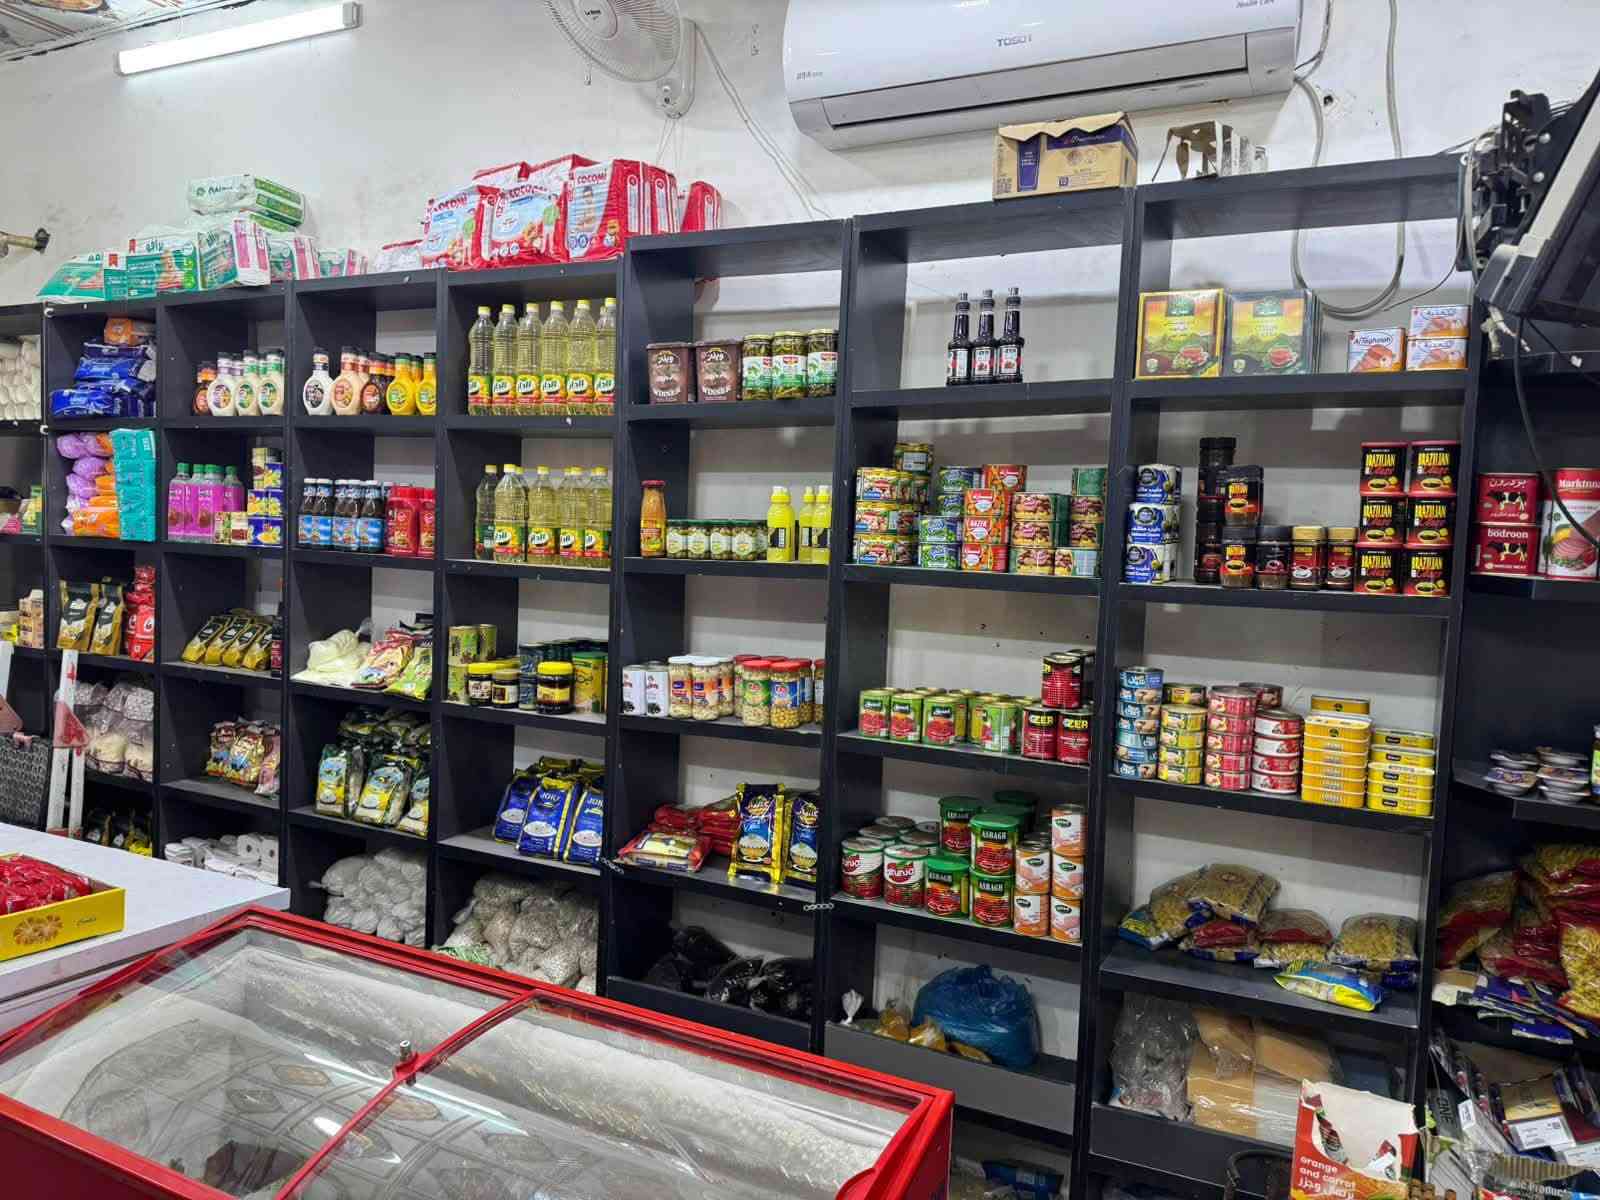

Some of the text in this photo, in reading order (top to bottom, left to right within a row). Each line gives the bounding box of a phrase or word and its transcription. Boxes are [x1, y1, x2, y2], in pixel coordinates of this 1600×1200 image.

[1365, 453, 1396, 466] BRAZILIAN
[1418, 452, 1450, 466] BRAZILIAN
[1363, 504, 1393, 518] BRAZILIAN
[1415, 504, 1447, 518] BRAZILIAN
[1361, 555, 1392, 568] BRAZILIAN
[1411, 556, 1443, 570] BRAZILIAN
[1300, 1156, 1338, 1173] orange
[1299, 1167, 1356, 1190] and carrot
